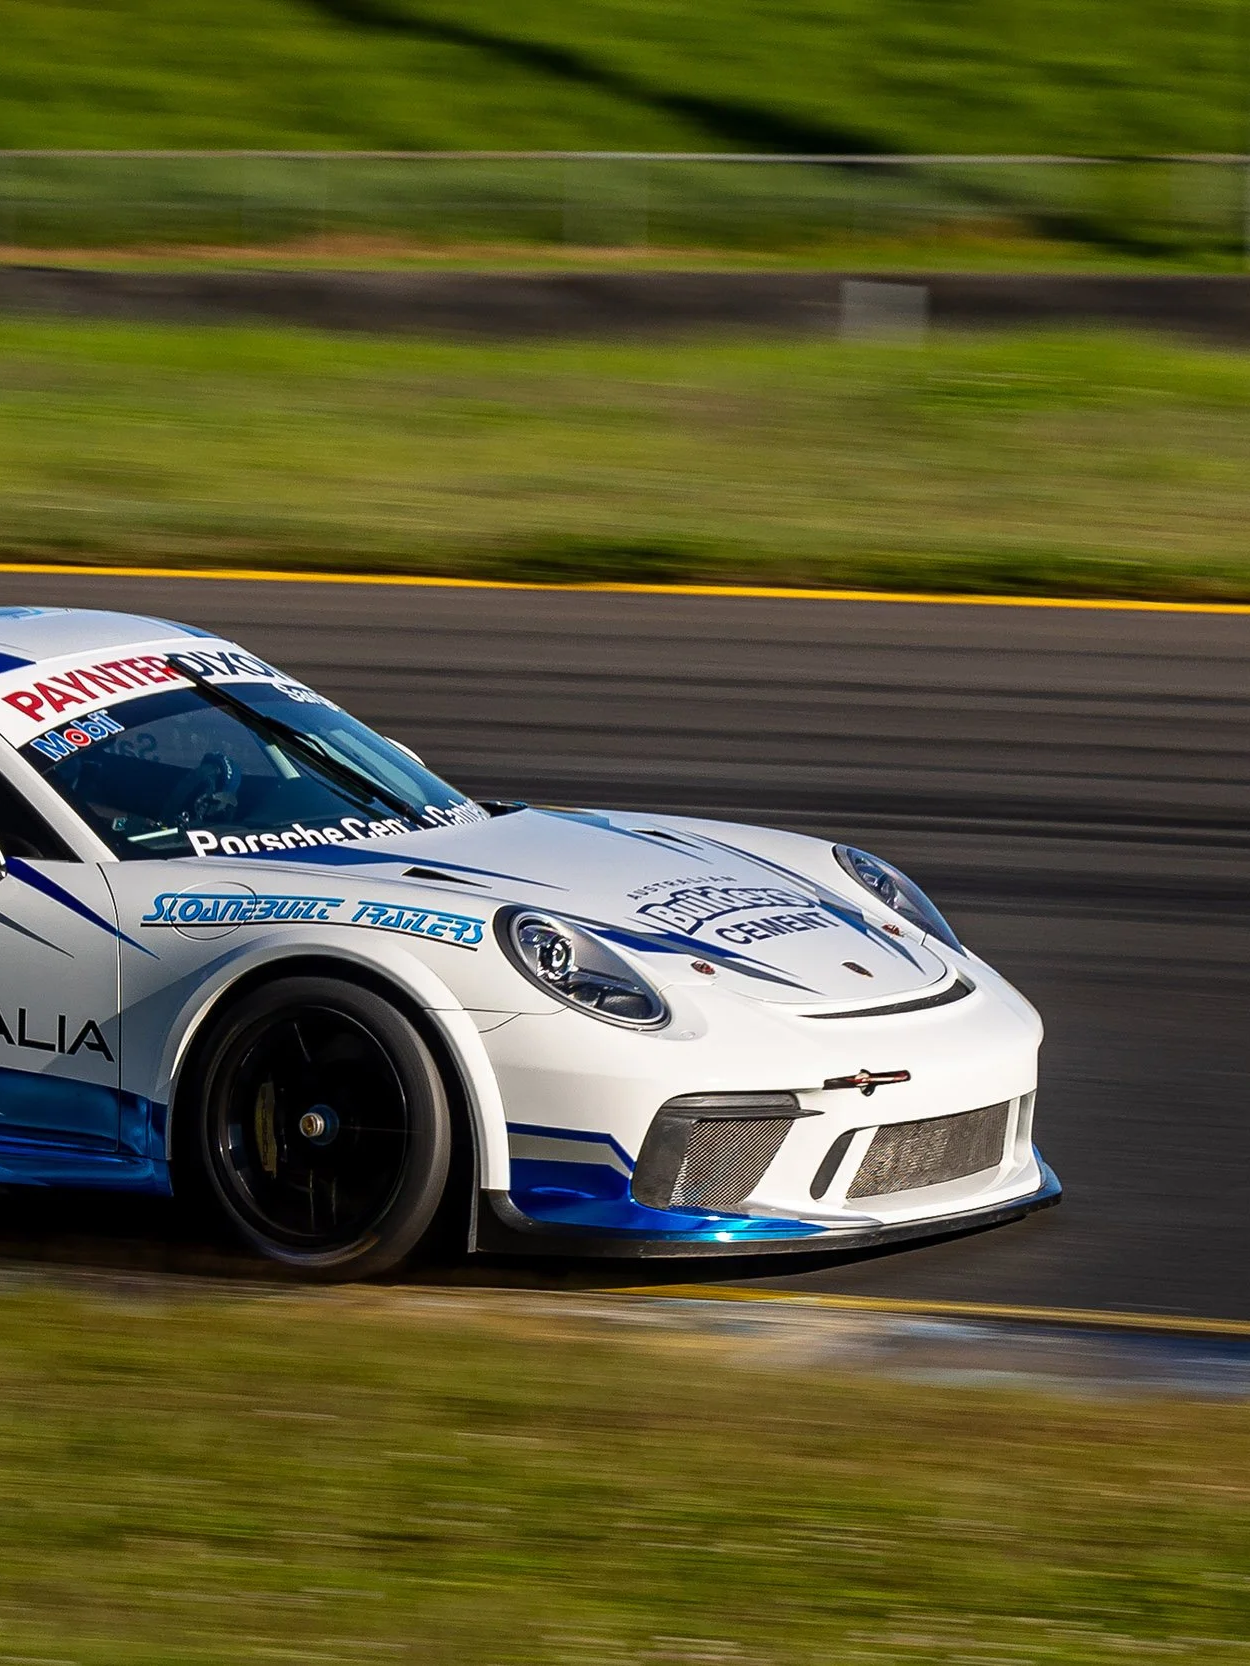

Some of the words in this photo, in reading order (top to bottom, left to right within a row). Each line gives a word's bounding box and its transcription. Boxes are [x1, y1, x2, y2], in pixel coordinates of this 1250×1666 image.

[1, 655, 186, 723] PAYNTER
[30, 709, 125, 762] Mobil
[186, 823, 349, 858] Porsche
[626, 875, 738, 901] AUSTRALIAN
[636, 886, 816, 936] Builders
[715, 911, 841, 945] CEMENT
